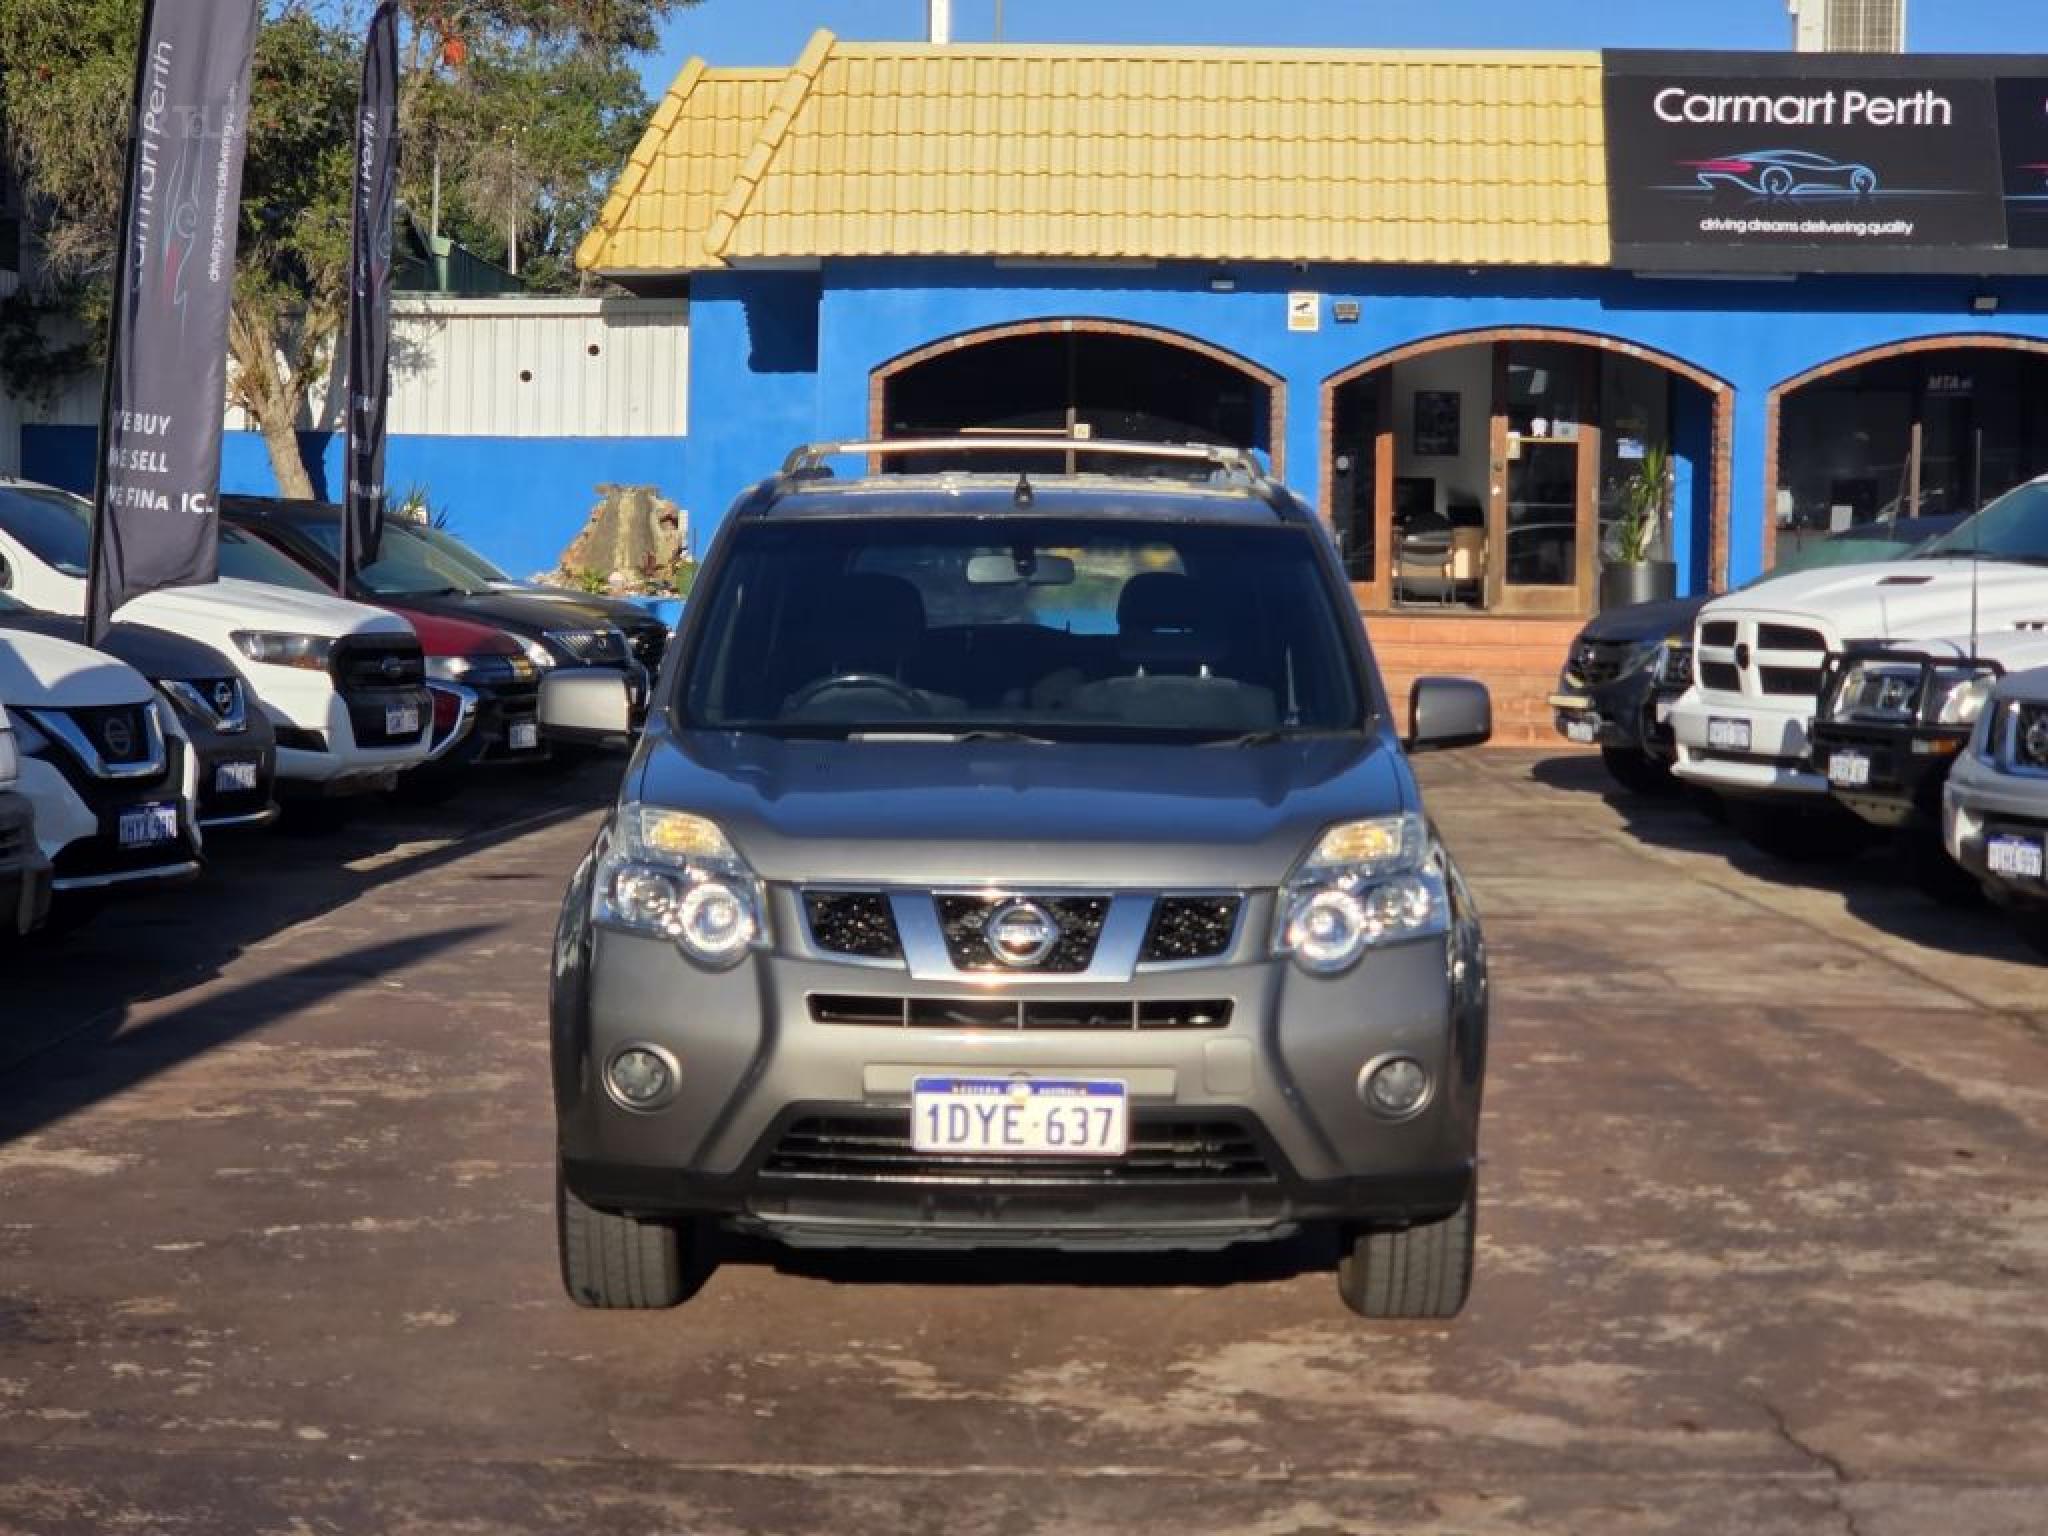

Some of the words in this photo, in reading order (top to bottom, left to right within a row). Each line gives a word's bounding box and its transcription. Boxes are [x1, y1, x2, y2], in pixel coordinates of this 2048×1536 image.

[144, 40, 173, 136] Perth
[1653, 87, 1837, 125] Carmart
[1843, 89, 1952, 126] Perth
[1699, 217, 1746, 235] driving
[1748, 217, 1799, 233] dreams
[1800, 219, 1866, 237] delivering
[1867, 218, 1914, 237] quality
[133, 412, 172, 436] BUY
[129, 449, 169, 474] SELL
[126, 487, 216, 514] FINAC
